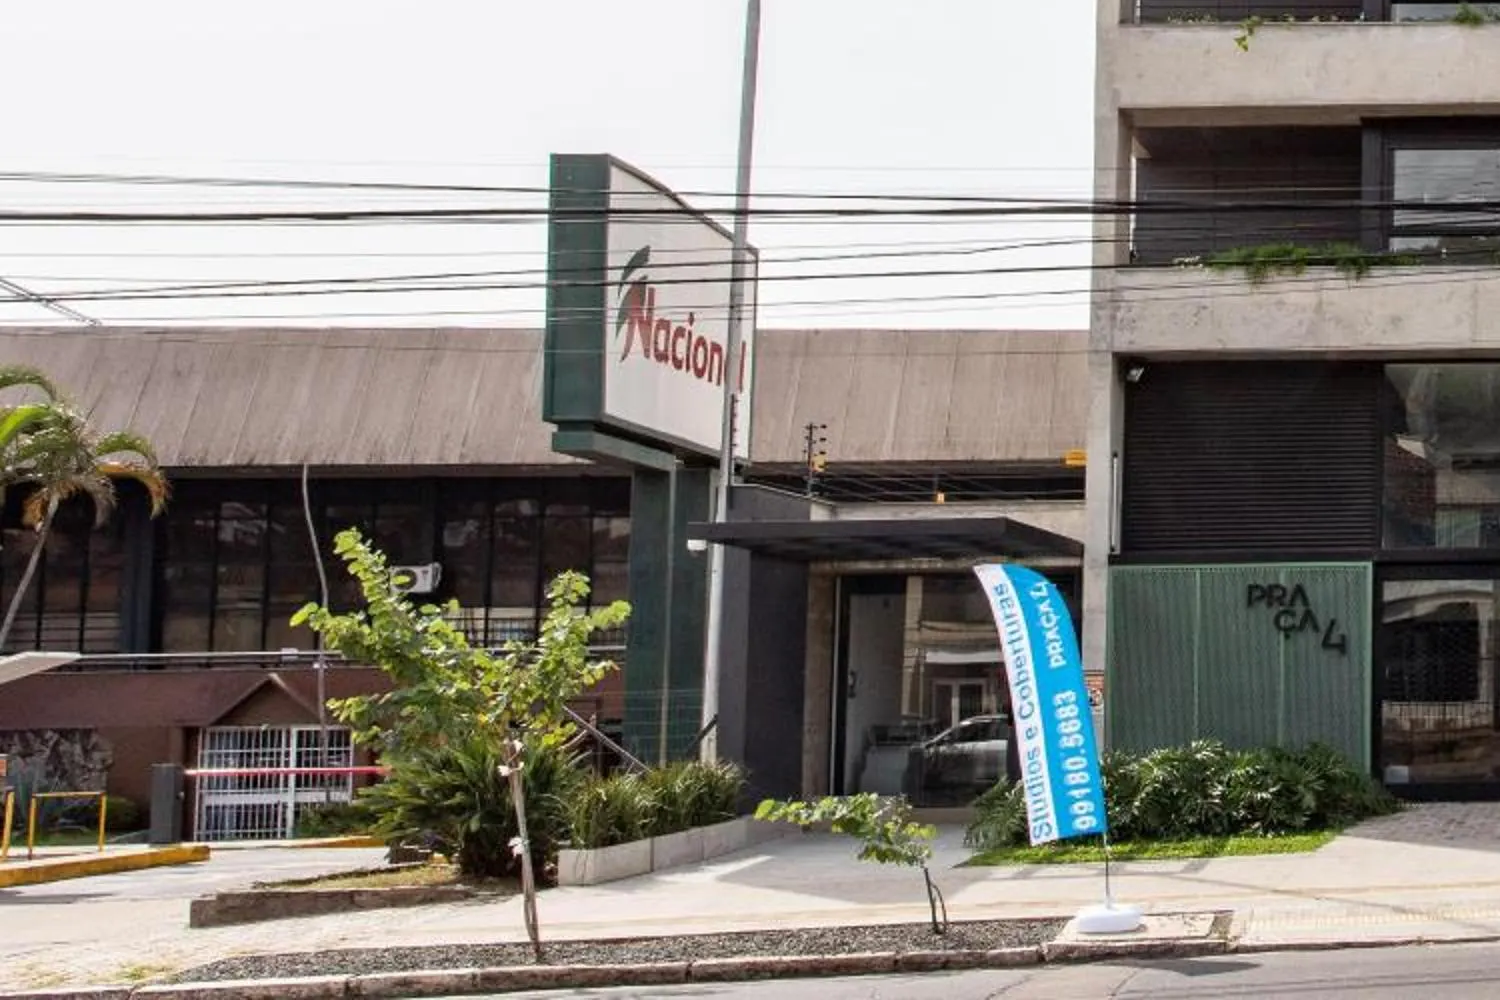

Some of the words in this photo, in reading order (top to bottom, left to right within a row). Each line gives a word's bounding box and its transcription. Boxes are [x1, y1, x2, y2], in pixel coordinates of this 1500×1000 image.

[620, 284, 746, 394] Nacionl
[994, 582, 1034, 721] Coberturas
[1321, 618, 1347, 655] 4
[1025, 726, 1039, 740] e
[1024, 747, 1053, 841] Studios
